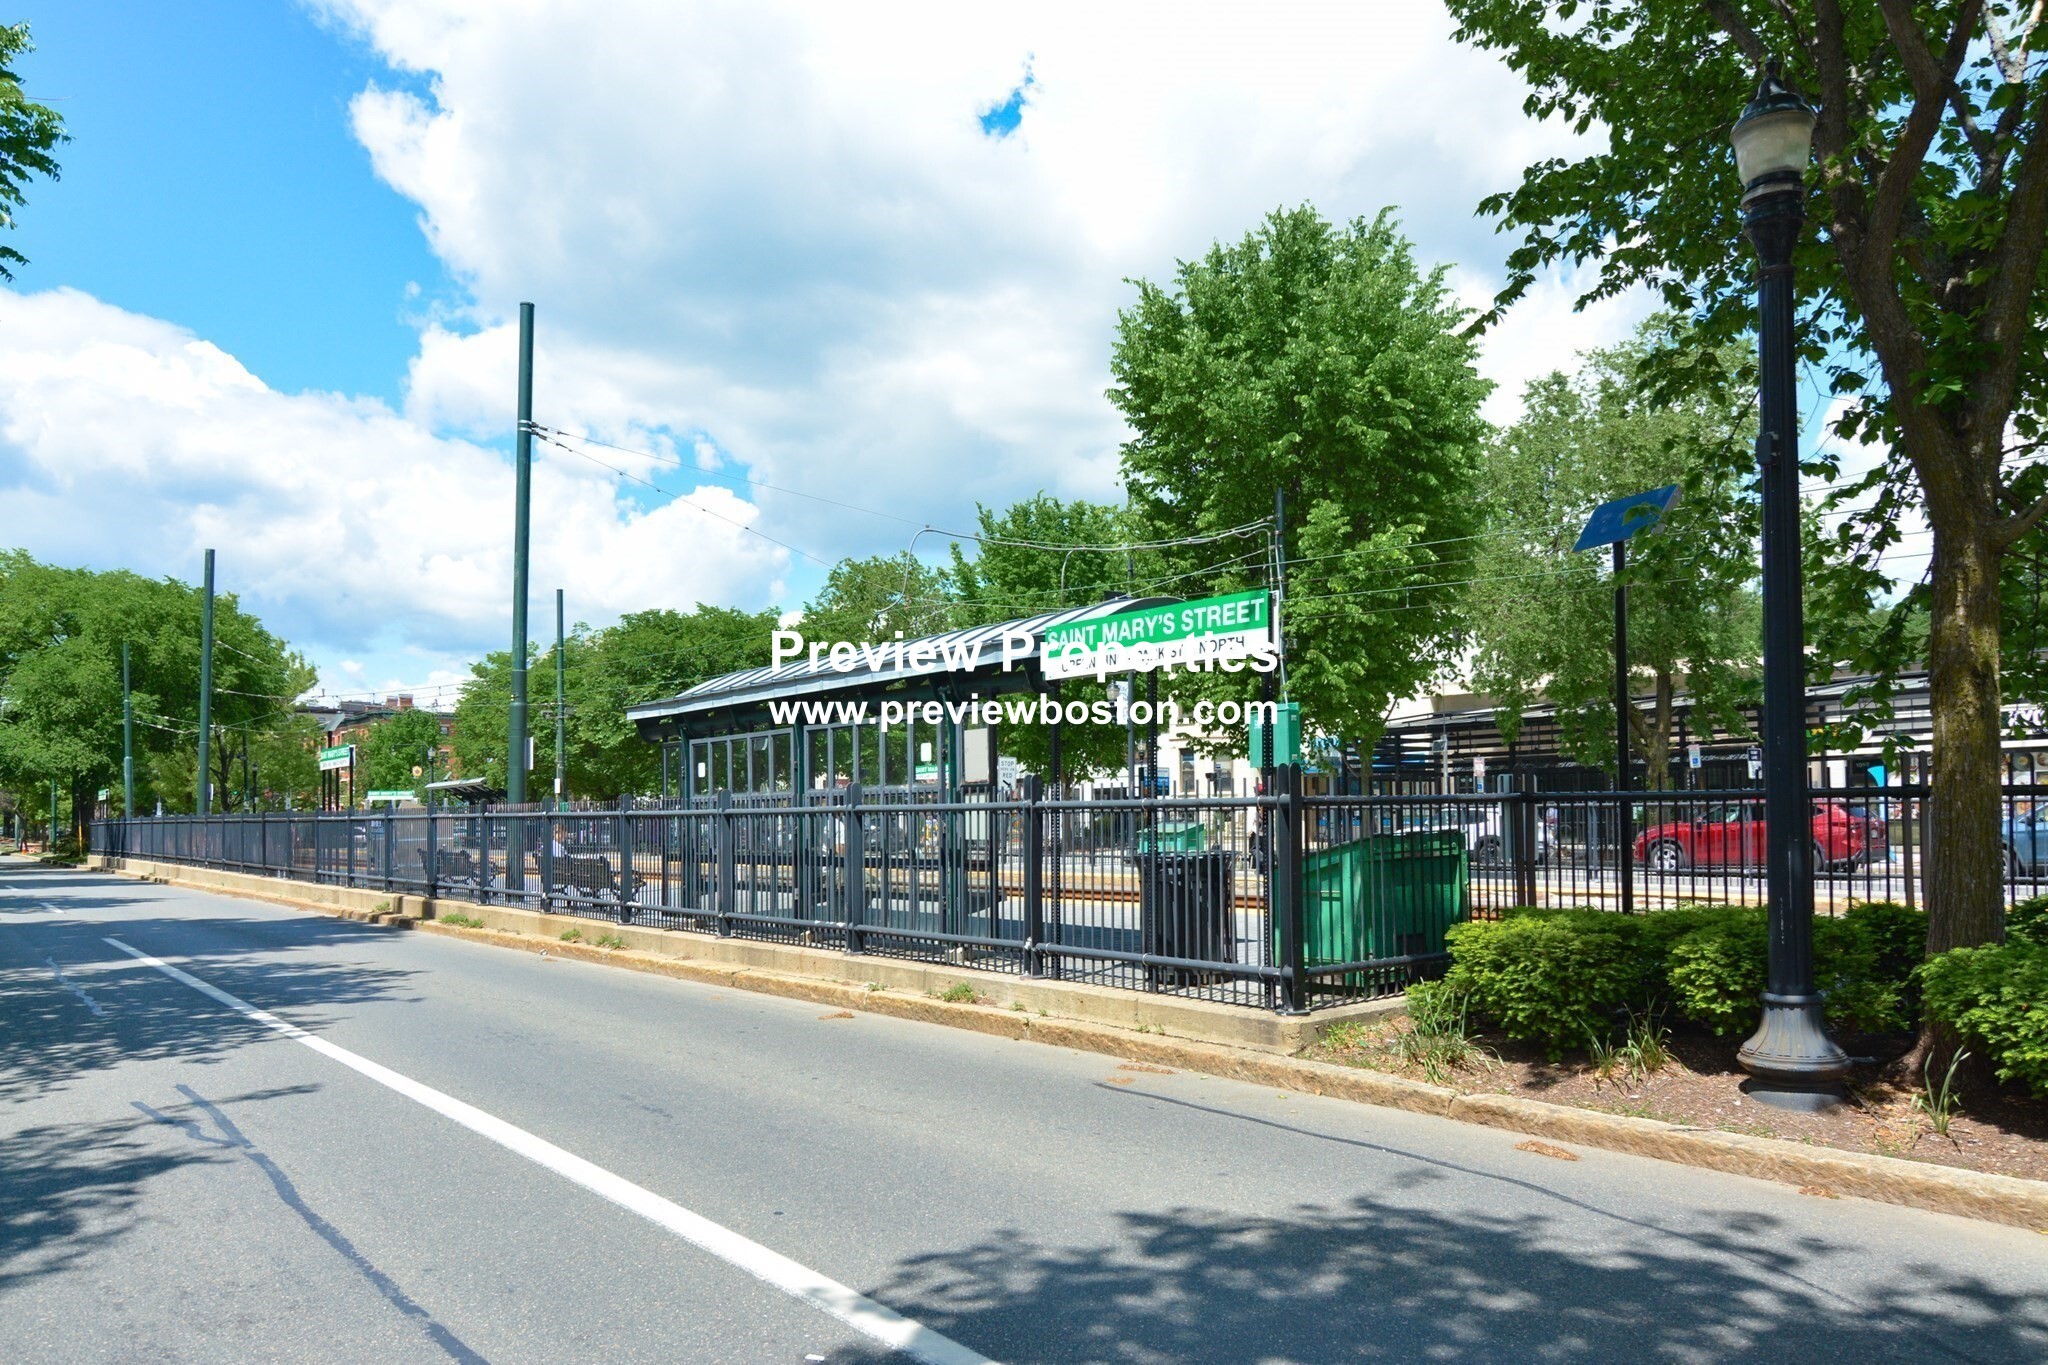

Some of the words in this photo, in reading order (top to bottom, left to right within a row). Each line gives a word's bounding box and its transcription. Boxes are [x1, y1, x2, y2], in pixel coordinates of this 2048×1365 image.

[1047, 625, 1097, 651] SAINT
[1102, 612, 1175, 643] MARY'S
[1181, 598, 1265, 631] STREET
